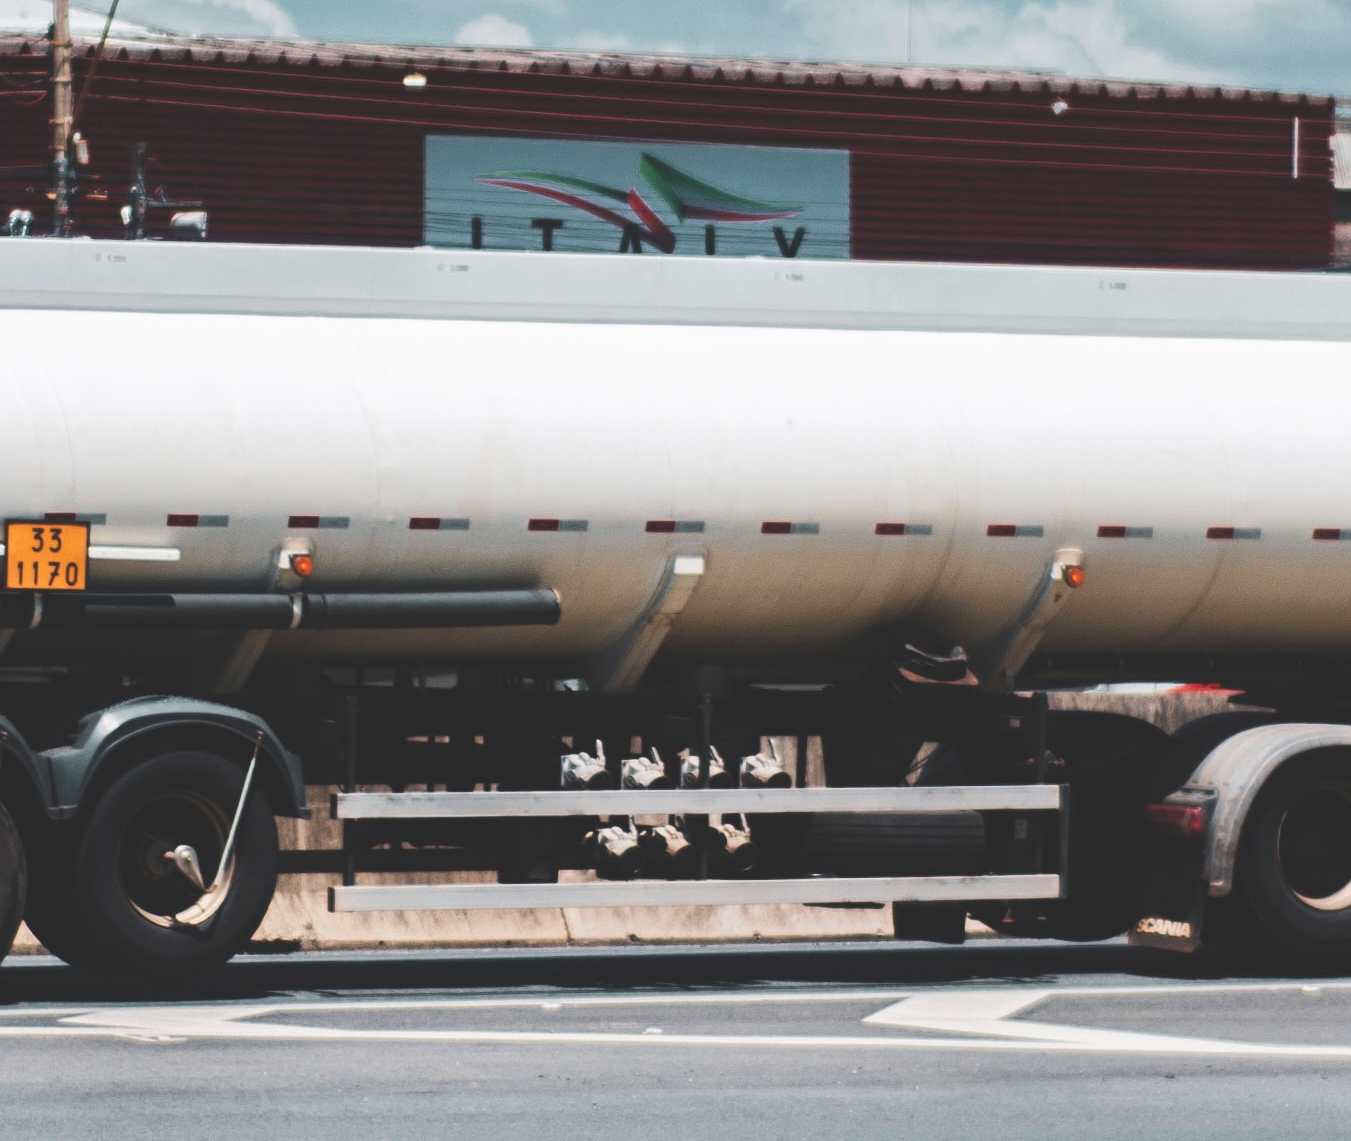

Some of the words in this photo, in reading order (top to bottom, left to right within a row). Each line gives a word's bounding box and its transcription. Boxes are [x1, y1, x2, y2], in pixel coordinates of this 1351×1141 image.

[31, 527, 63, 553] 33
[17, 561, 79, 587] 1170
[1137, 918, 1191, 938] SCANIA
